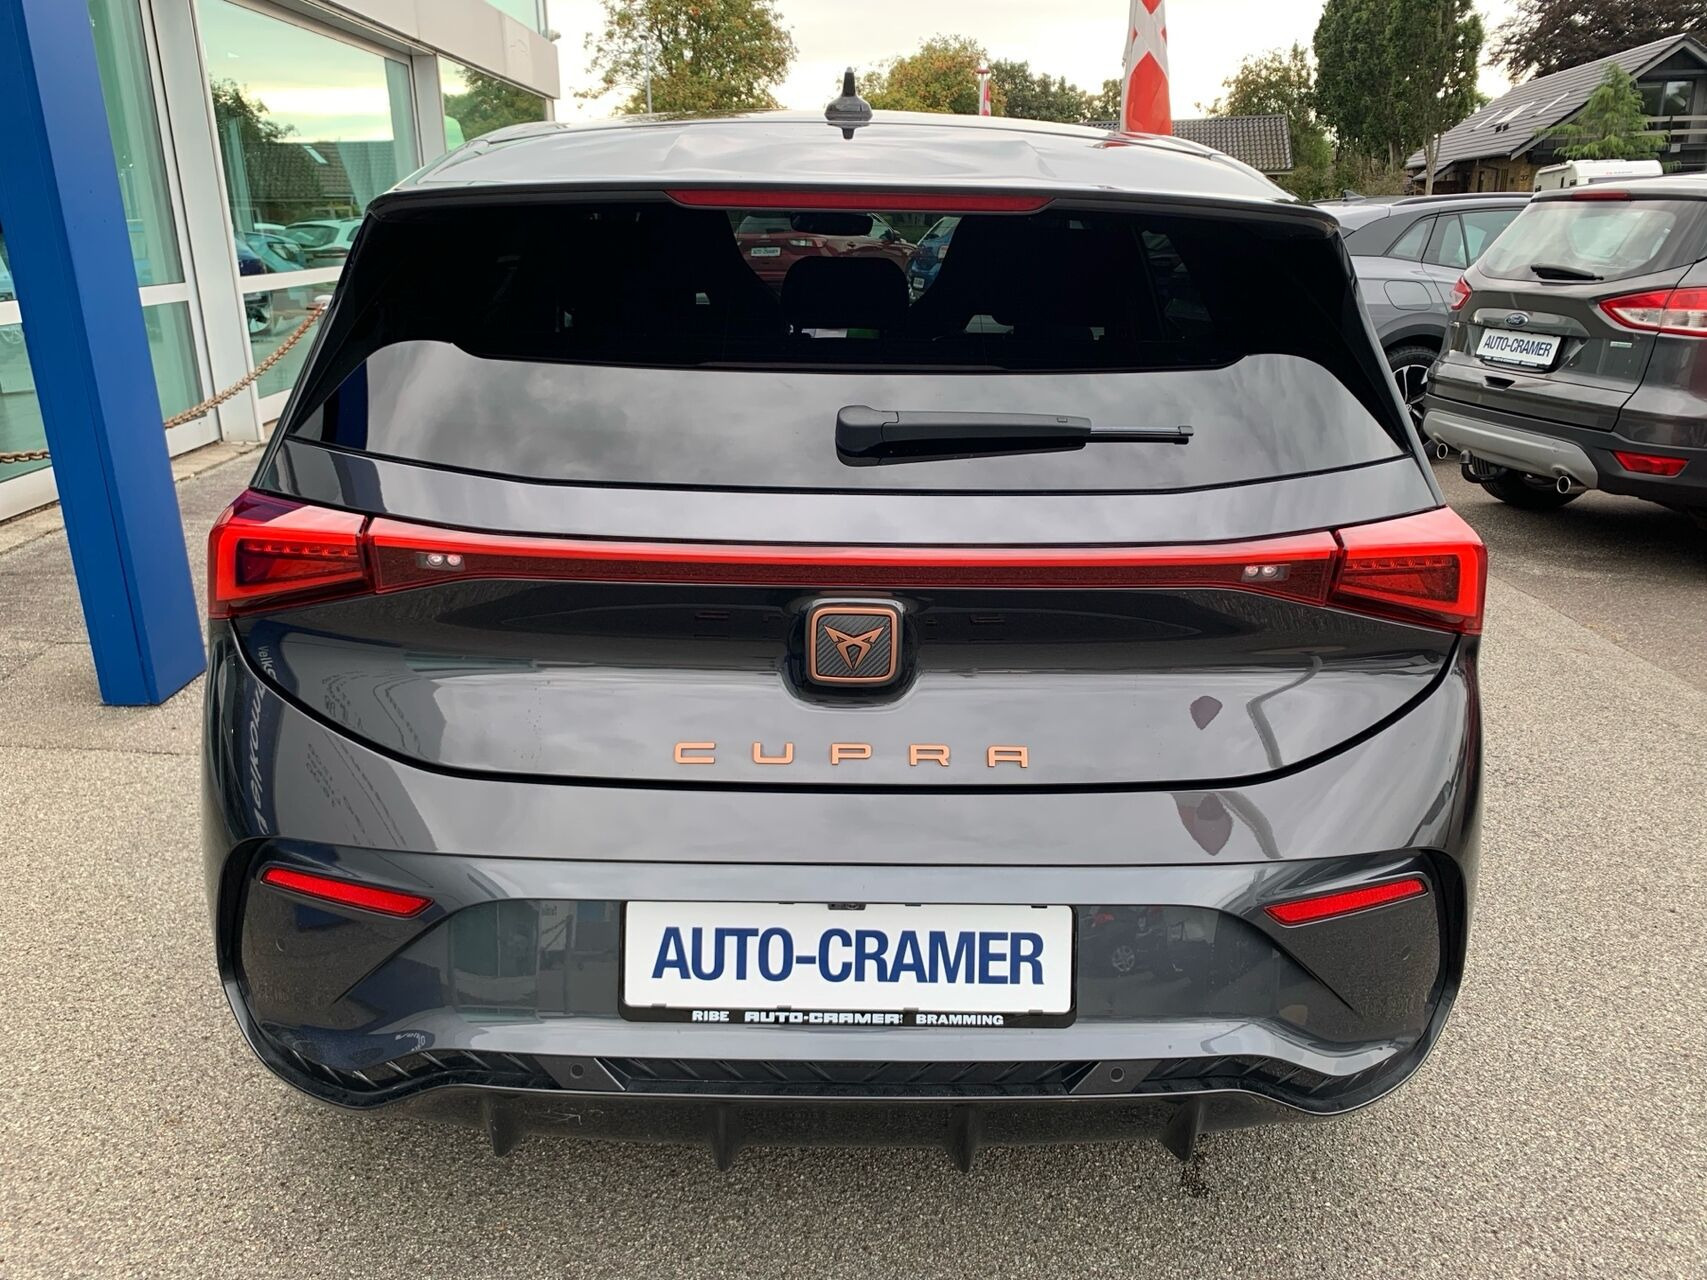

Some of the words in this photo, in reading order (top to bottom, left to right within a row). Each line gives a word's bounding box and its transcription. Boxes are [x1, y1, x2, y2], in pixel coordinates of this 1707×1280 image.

[1483, 335, 1552, 357] AUTO-CRAMER
[673, 742, 1029, 768] CUPRA
[651, 926, 1045, 985] AUTO-CRAMER
[692, 1010, 729, 1022] RIBE
[744, 1011, 899, 1025] AUTO-CRAMER
[915, 1014, 1004, 1026] BRAMMING
